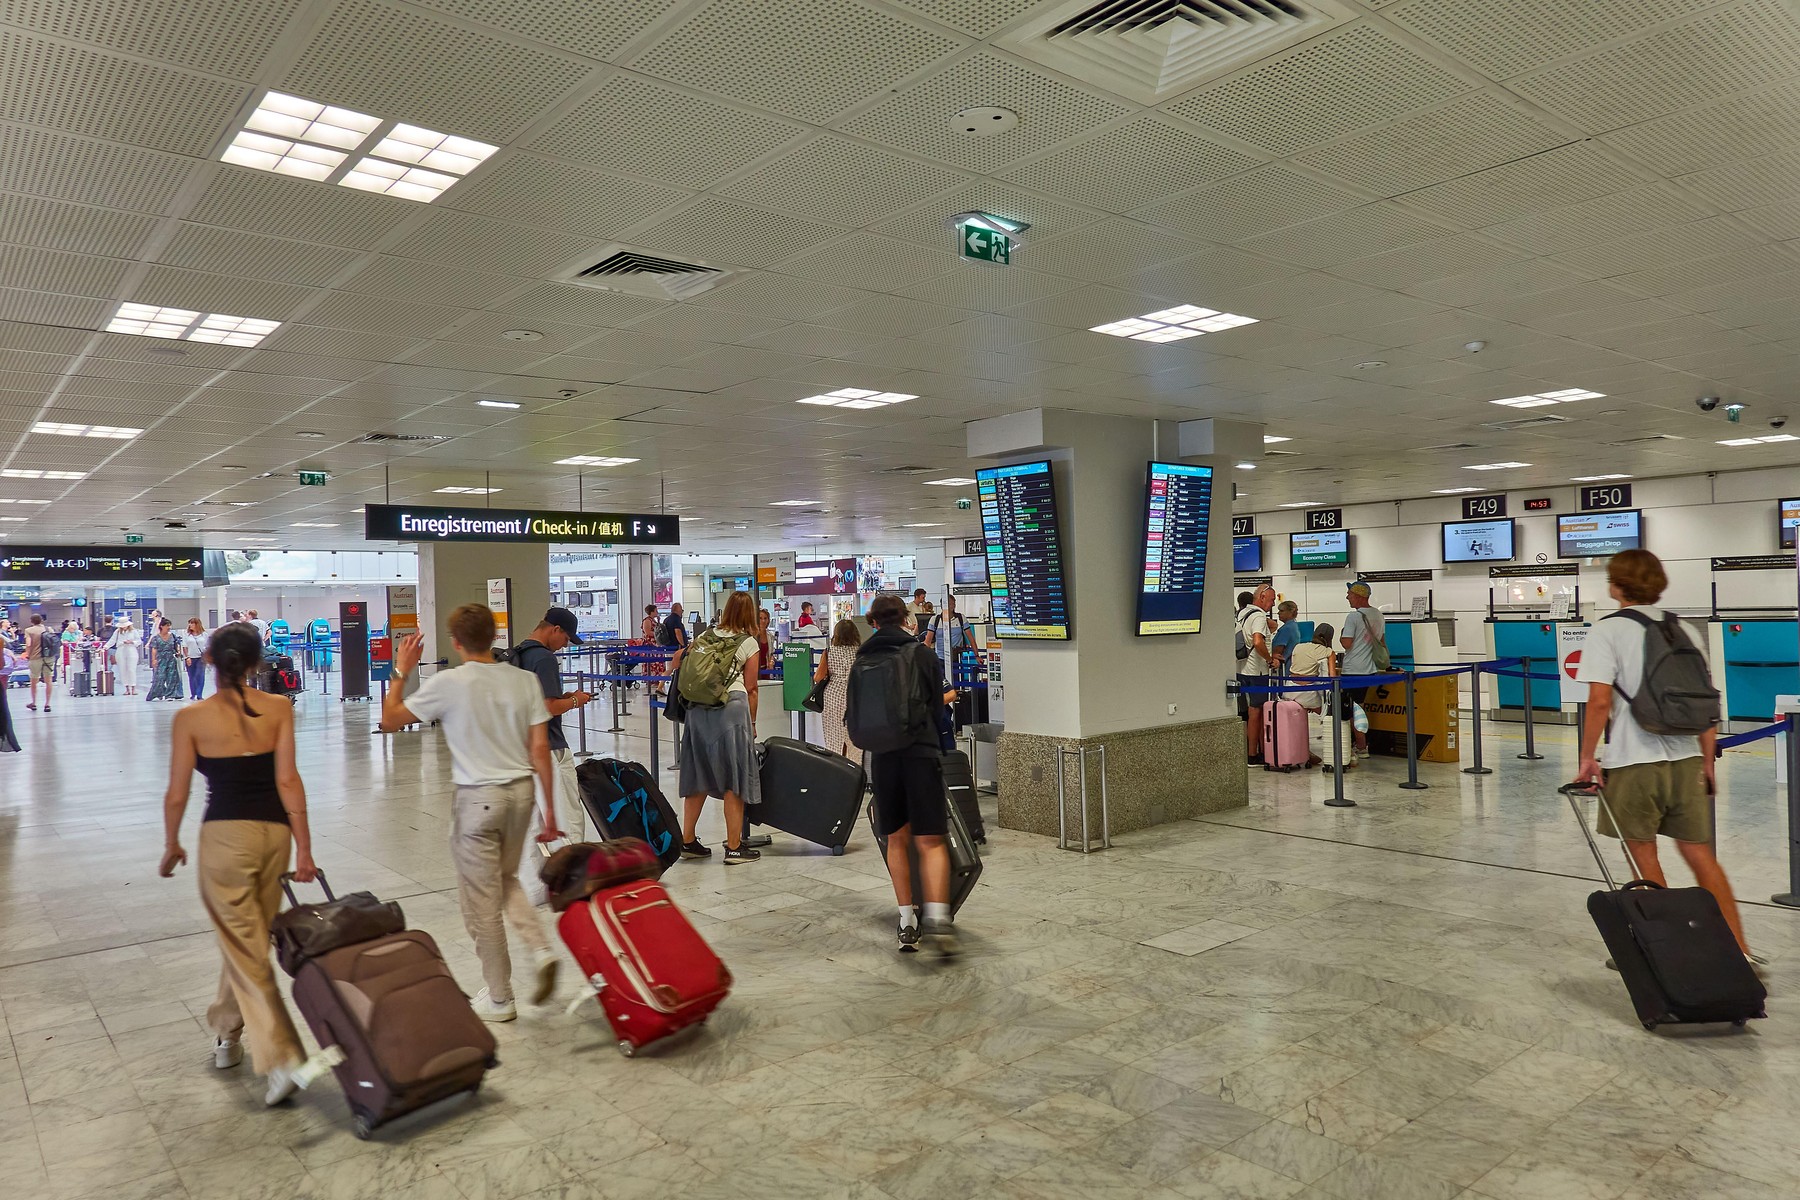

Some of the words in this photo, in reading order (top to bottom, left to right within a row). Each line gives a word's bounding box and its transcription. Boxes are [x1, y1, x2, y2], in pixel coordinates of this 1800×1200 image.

[1530, 500, 1547, 508] 14:53
[1589, 488, 1621, 507] F50
[1469, 498, 1497, 516] F49
[401, 513, 521, 537] Enregistrement
[532, 518, 588, 536] Check-in
[598, 521, 624, 536] 值机
[633, 520, 641, 537] F
[1233, 519, 1247, 533] 47
[1313, 512, 1335, 528] F48
[968, 541, 981, 553] F44
[45, 559, 86, 568] A-B-C-D
[122, 560, 128, 568] E
[1364, 703, 1418, 715] RGAMON
